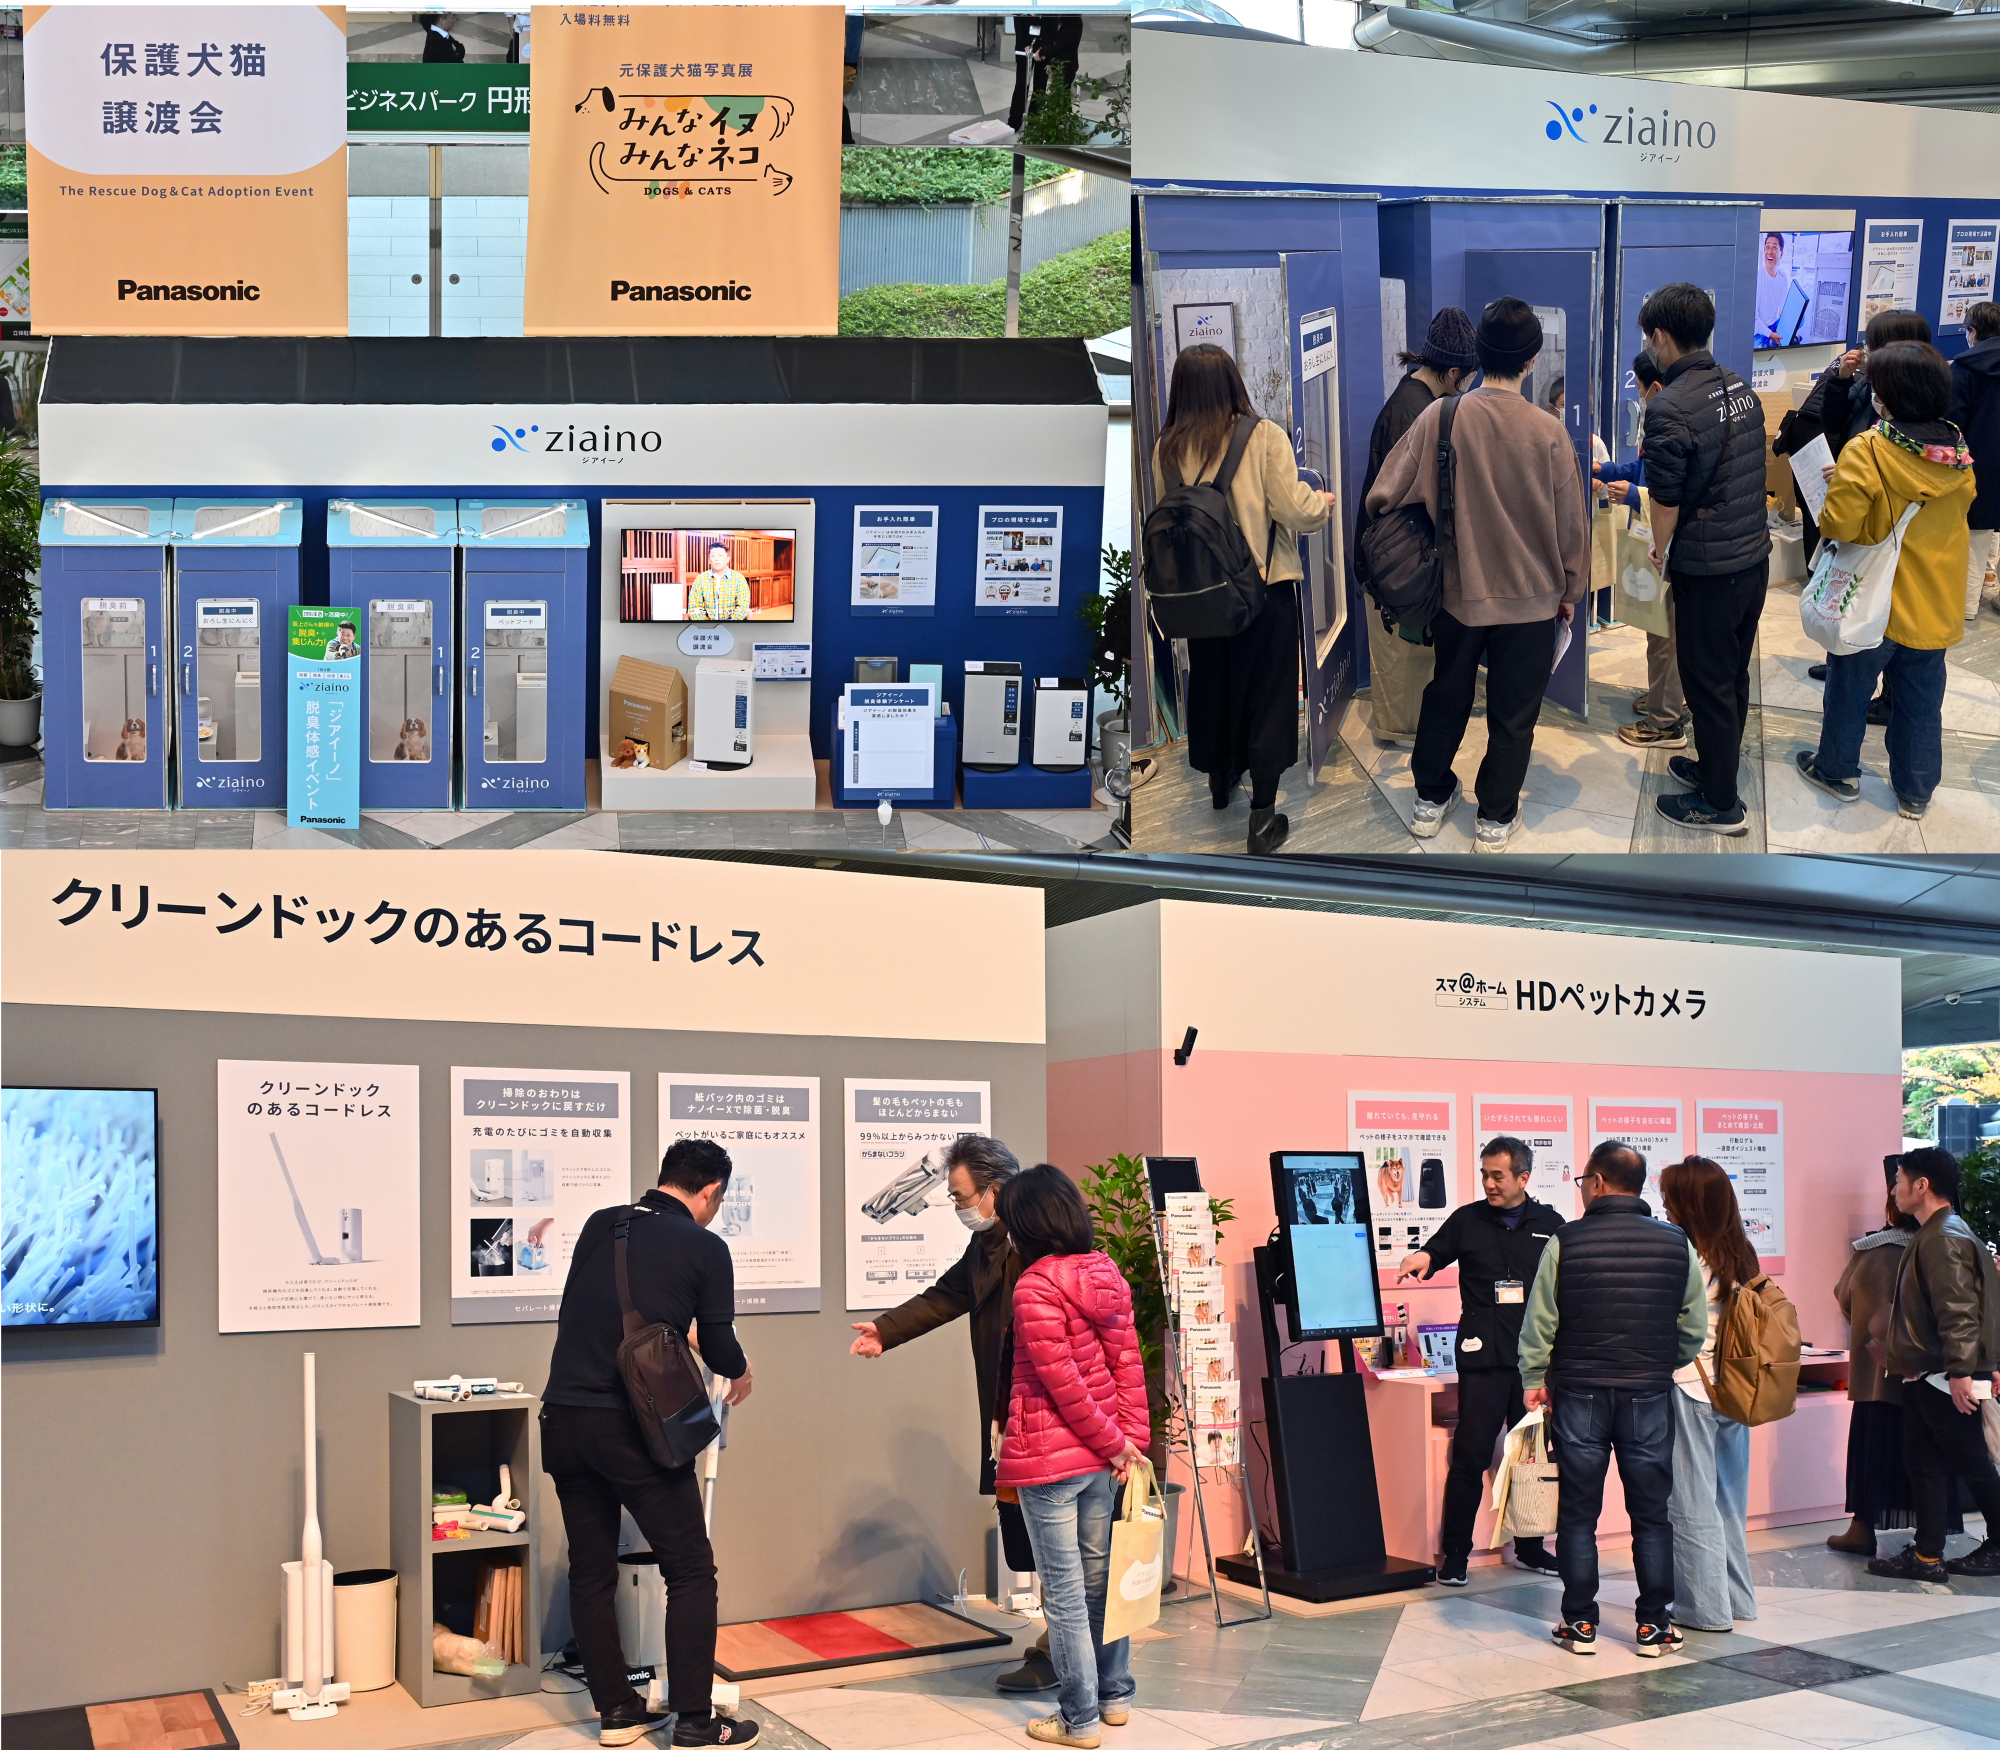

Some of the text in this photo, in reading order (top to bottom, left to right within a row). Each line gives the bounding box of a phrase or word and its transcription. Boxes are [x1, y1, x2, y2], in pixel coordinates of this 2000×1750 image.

[560, 13, 630, 26] 入場料無料
[101, 43, 267, 78] 保護犬猫
[619, 63, 753, 77] 元保護犬猫写真展
[102, 101, 224, 135] 譲渡会
[619, 106, 758, 138] みんなイヌ
[1603, 106, 1716, 149] ziaino
[619, 139, 759, 171] みんなネコ
[1640, 152, 1681, 163] ジアイーノ
[60, 186, 85, 198] The
[89, 186, 137, 198] Rescue
[208, 186, 271, 200] Adoption
[275, 186, 314, 198] Event
[643, 186, 731, 196] DOGS & CATS
[117, 280, 260, 302] Panasonic
[610, 280, 752, 302] Panasonic
[1189, 327, 1223, 337] ziaino
[1624, 369, 1636, 389] 2
[1573, 404, 1580, 426] 1
[545, 424, 662, 452] ziaino
[1296, 427, 1303, 455] 2
[99, 601, 127, 609] 脱臭前
[150, 645, 156, 657] 1
[184, 646, 193, 657] 2
[437, 646, 443, 658] 1
[470, 647, 480, 659] 2
[315, 682, 350, 692] ziaino
[623, 699, 652, 711] Panasonic
[305, 700, 320, 810] 脱臭体感イベント
[217, 776, 264, 788] ziaino
[502, 777, 550, 789] ziaino
[300, 815, 345, 824] Panasonic
[52, 878, 765, 968] クリーンドックのあるコードレス
[1435, 973, 1706, 1020] スマ@ホーム HDペットカメラ
[1459, 997, 1486, 1007] システム
[260, 1080, 380, 1097] クリーンドック
[502, 1087, 580, 1099] 掃除のおわりは
[695, 1092, 785, 1104] 紙パック内のゴミは
[872, 1097, 963, 1107] 髪の毛もペットの毛も
[247, 1102, 391, 1118] のあるコードレス
[476, 1100, 606, 1112] クリーンドックに戻すだけ
[878, 1108, 958, 1118] ほとんどからまない
[1366, 1111, 1439, 1121] 離れていても、見守れる
[1484, 1114, 1564, 1124] いたずらされても倒れにくい
[1721, 1113, 1760, 1121] ペットの様子を
[1600, 1116, 1672, 1125] ペットの様子を自在に確認
[472, 1127, 613, 1138] 充電のたびにゴミを自動収集
[675, 1130, 806, 1140] ペットがいるご家庭にもオススメ
[860, 1132, 955, 1142] 99%以上からみつかない
